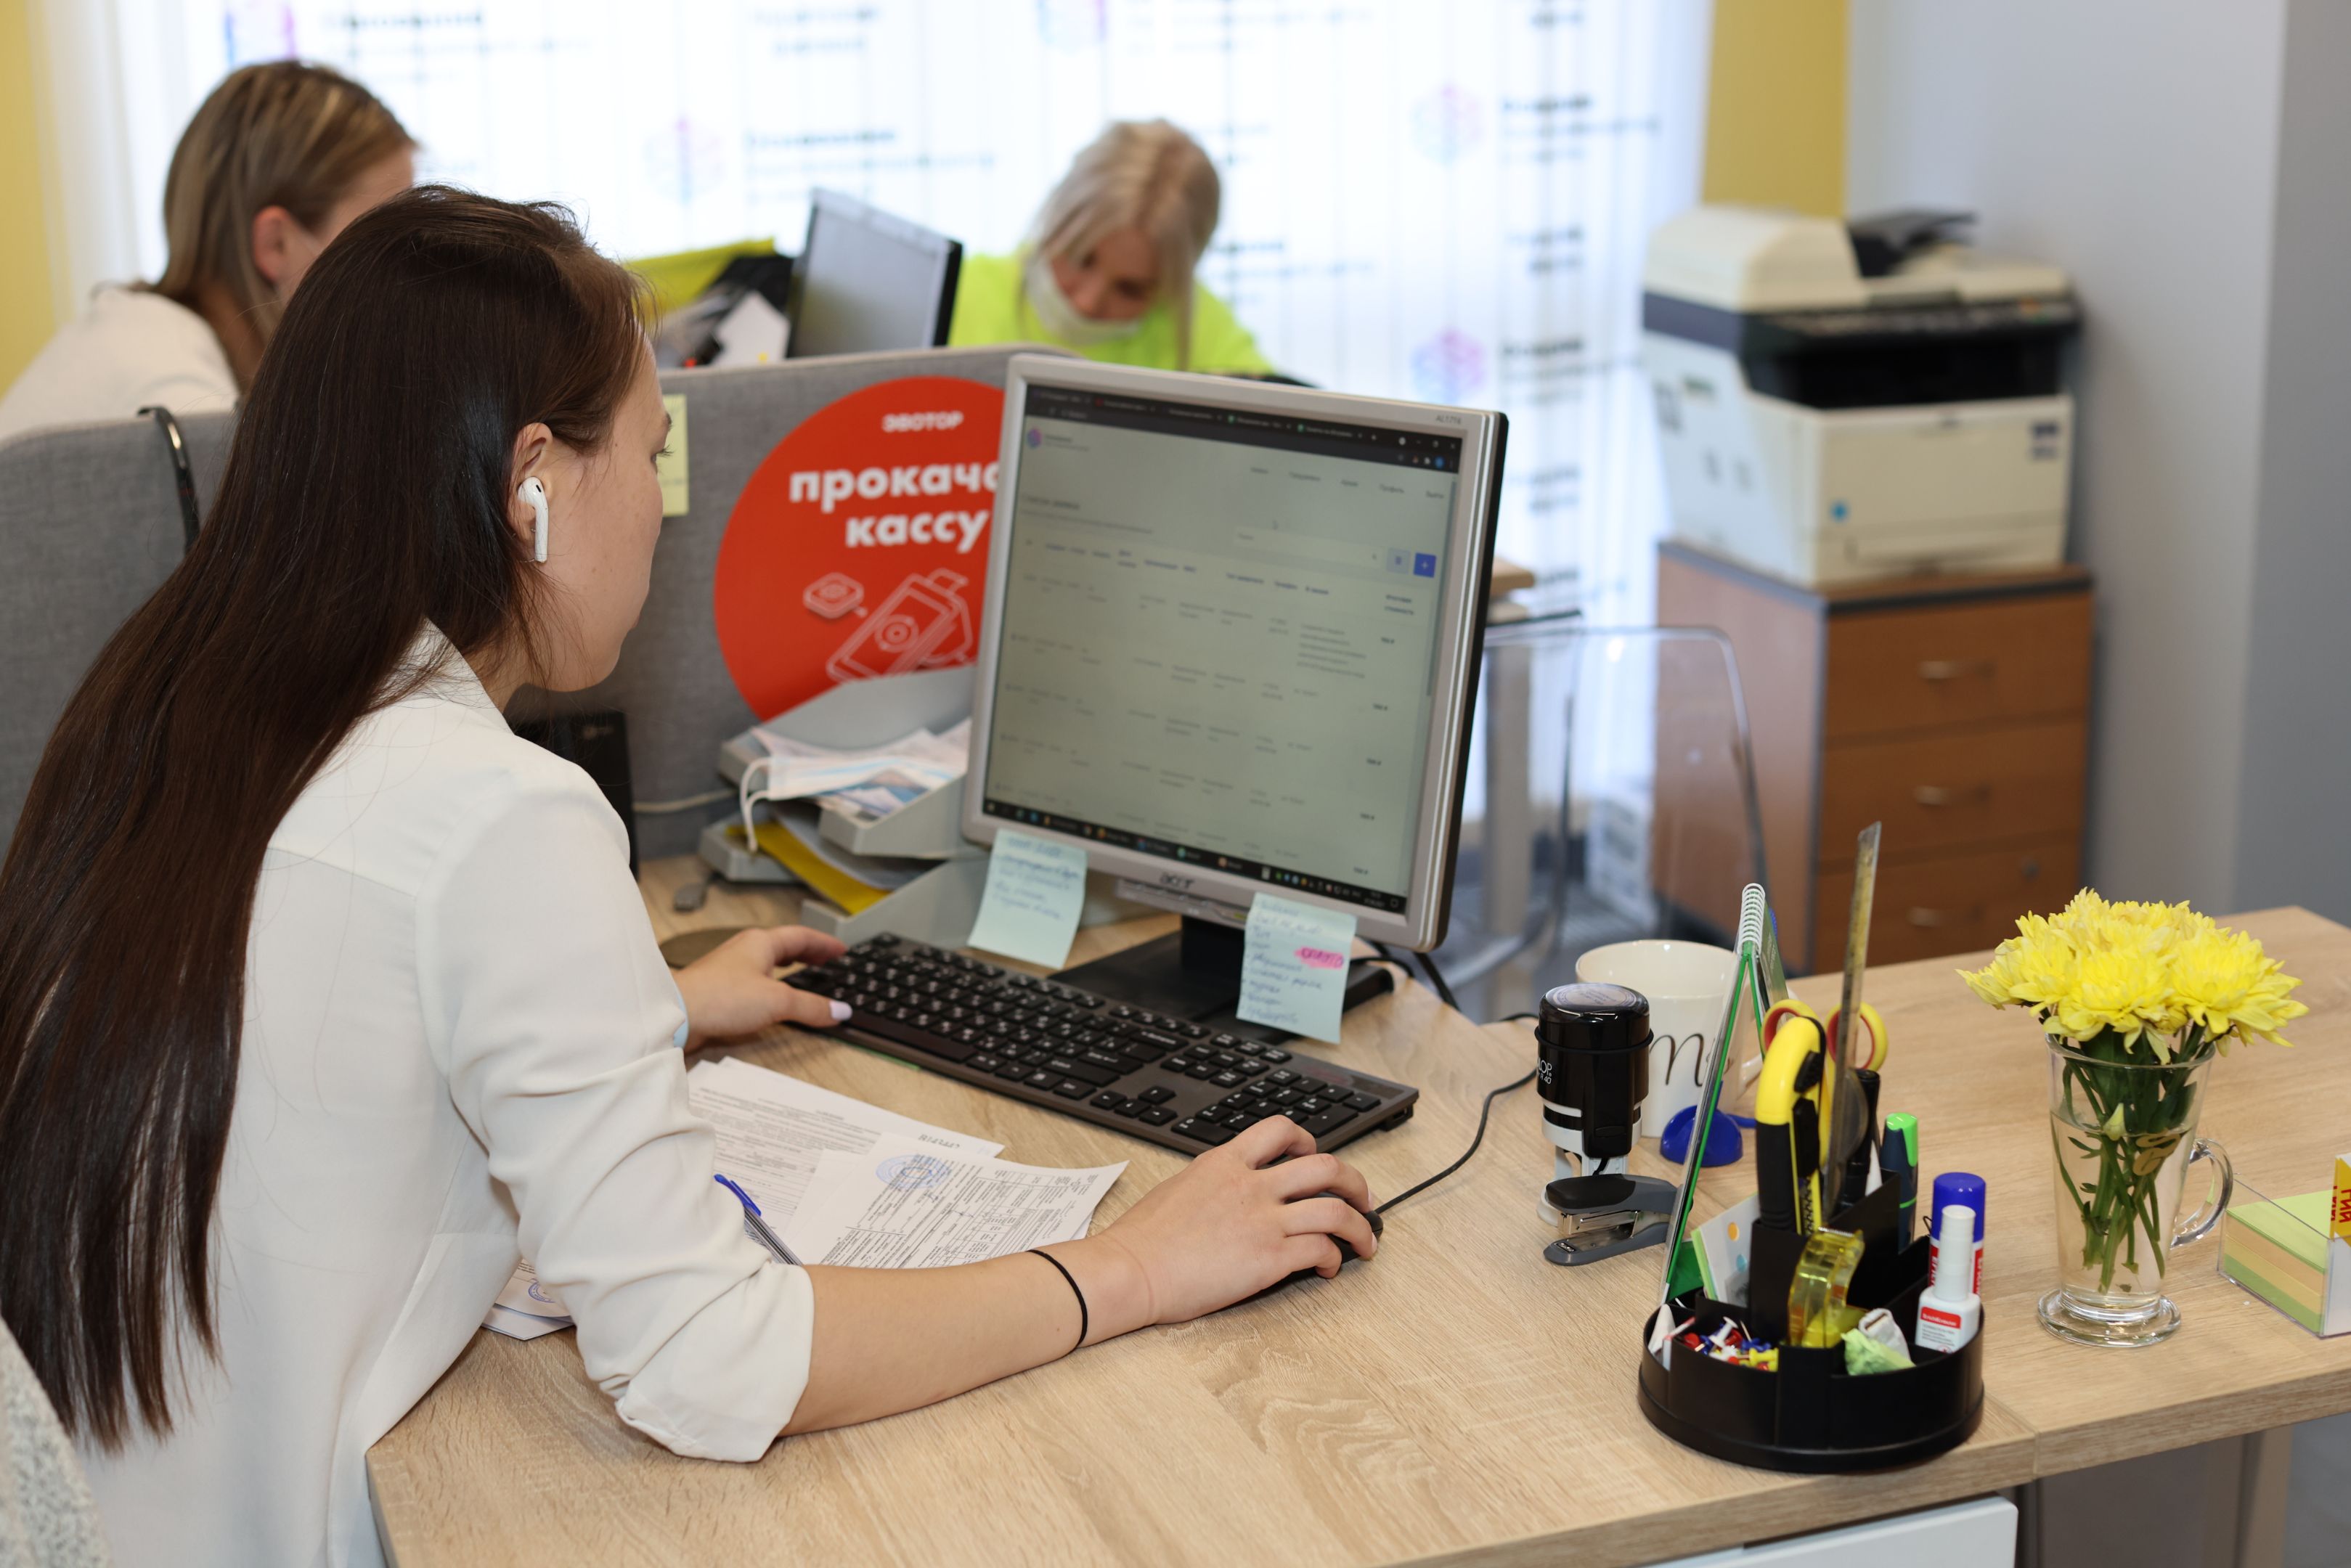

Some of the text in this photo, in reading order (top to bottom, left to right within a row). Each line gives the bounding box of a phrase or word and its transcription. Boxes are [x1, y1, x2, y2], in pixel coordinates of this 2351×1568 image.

[882, 412, 963, 432] ЭВОТОР
[789, 462, 998, 513] прокача
[846, 511, 990, 552] кассу
